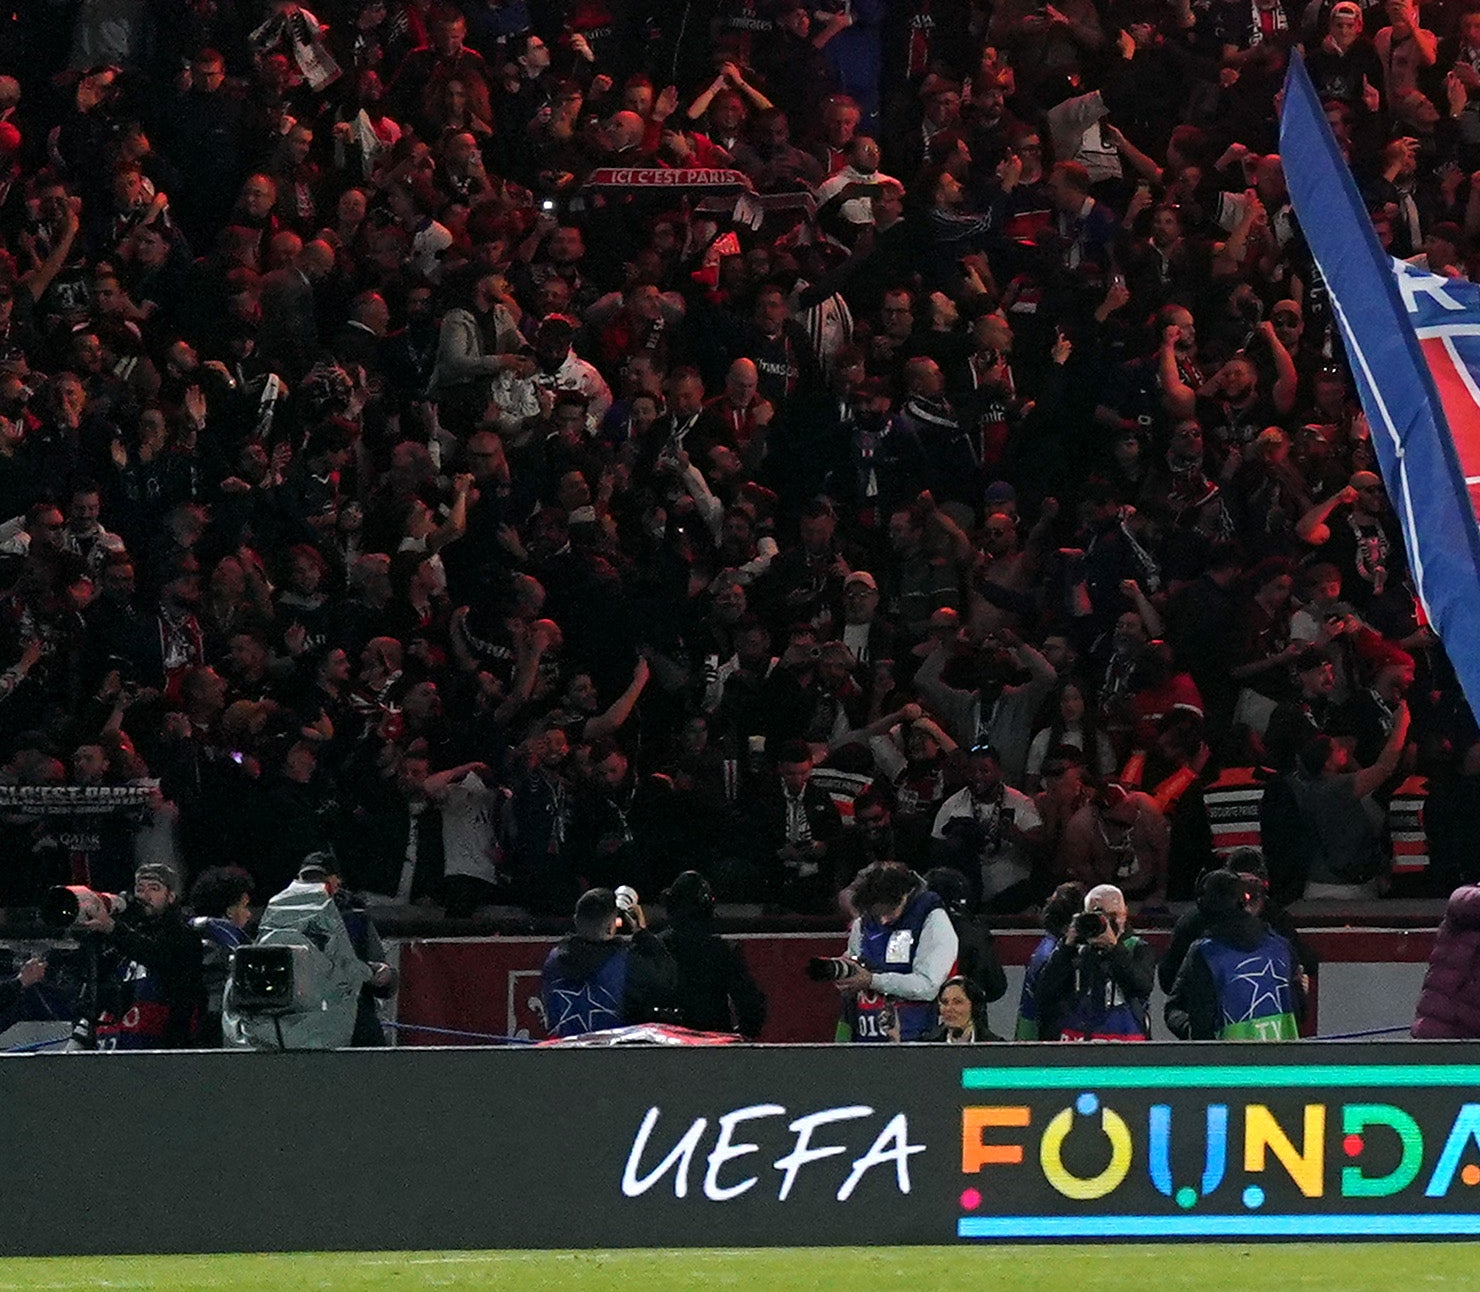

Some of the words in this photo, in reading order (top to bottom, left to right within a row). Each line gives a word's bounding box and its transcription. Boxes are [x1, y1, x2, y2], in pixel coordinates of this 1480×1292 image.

[610, 170, 632, 183] ICI
[637, 169, 679, 183] C'EST
[684, 170, 736, 184] PARIS
[1255, 1022, 1282, 1042] TV
[621, 1103, 927, 1202] UEFA
